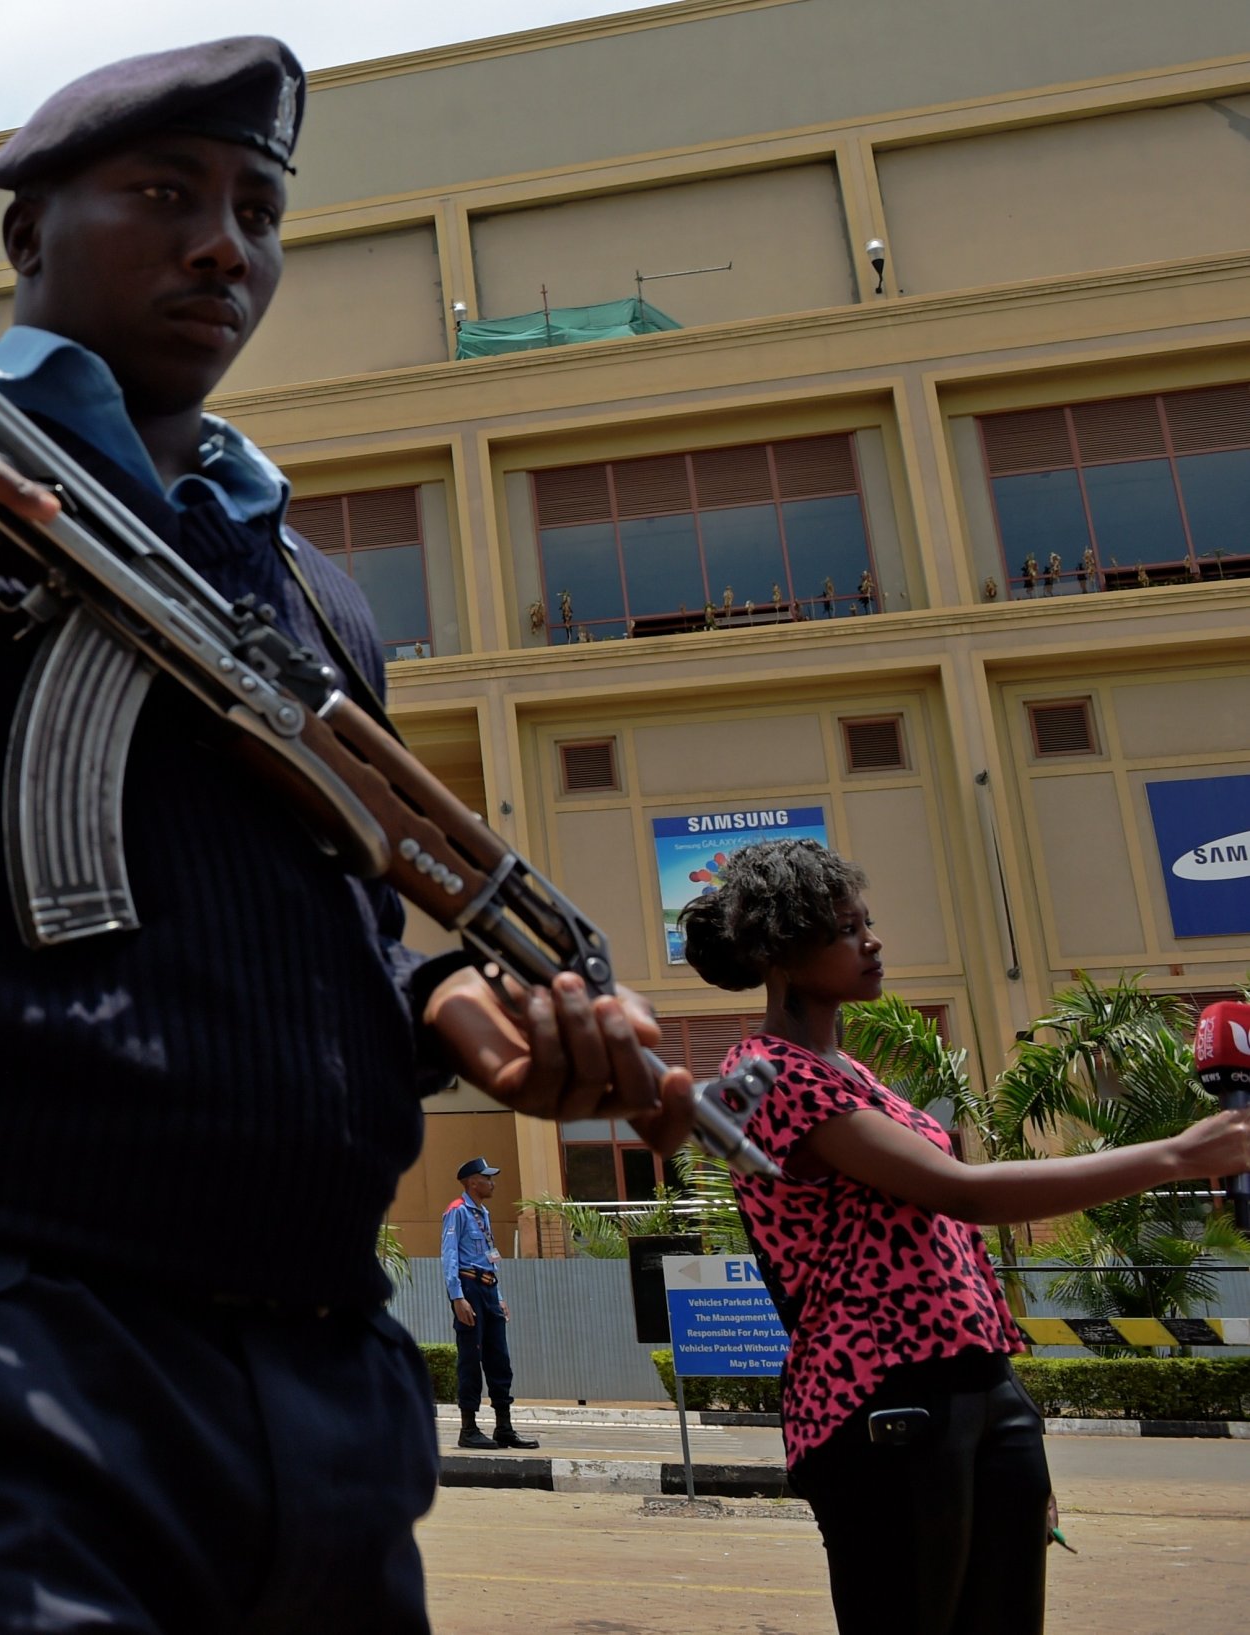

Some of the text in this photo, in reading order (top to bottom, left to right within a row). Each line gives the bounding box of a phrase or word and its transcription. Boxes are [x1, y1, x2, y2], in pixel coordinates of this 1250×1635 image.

[687, 810, 789, 832] SAMSUNG
[1193, 845, 1248, 865] SAM
[1201, 1072, 1220, 1083] NEWS
[688, 1298, 722, 1307] Vehicles
[723, 1298, 752, 1306] Parked
[753, 1298, 763, 1306] At
[695, 1314, 711, 1322] The
[712, 1313, 766, 1323] Management
[687, 1329, 736, 1338] Responsible
[753, 1329, 769, 1338] Any
[679, 1344, 713, 1352] Vehicles
[714, 1344, 743, 1352] Parked
[744, 1344, 778, 1352] Without
[729, 1360, 747, 1369] May
[749, 1360, 760, 1368] Be
